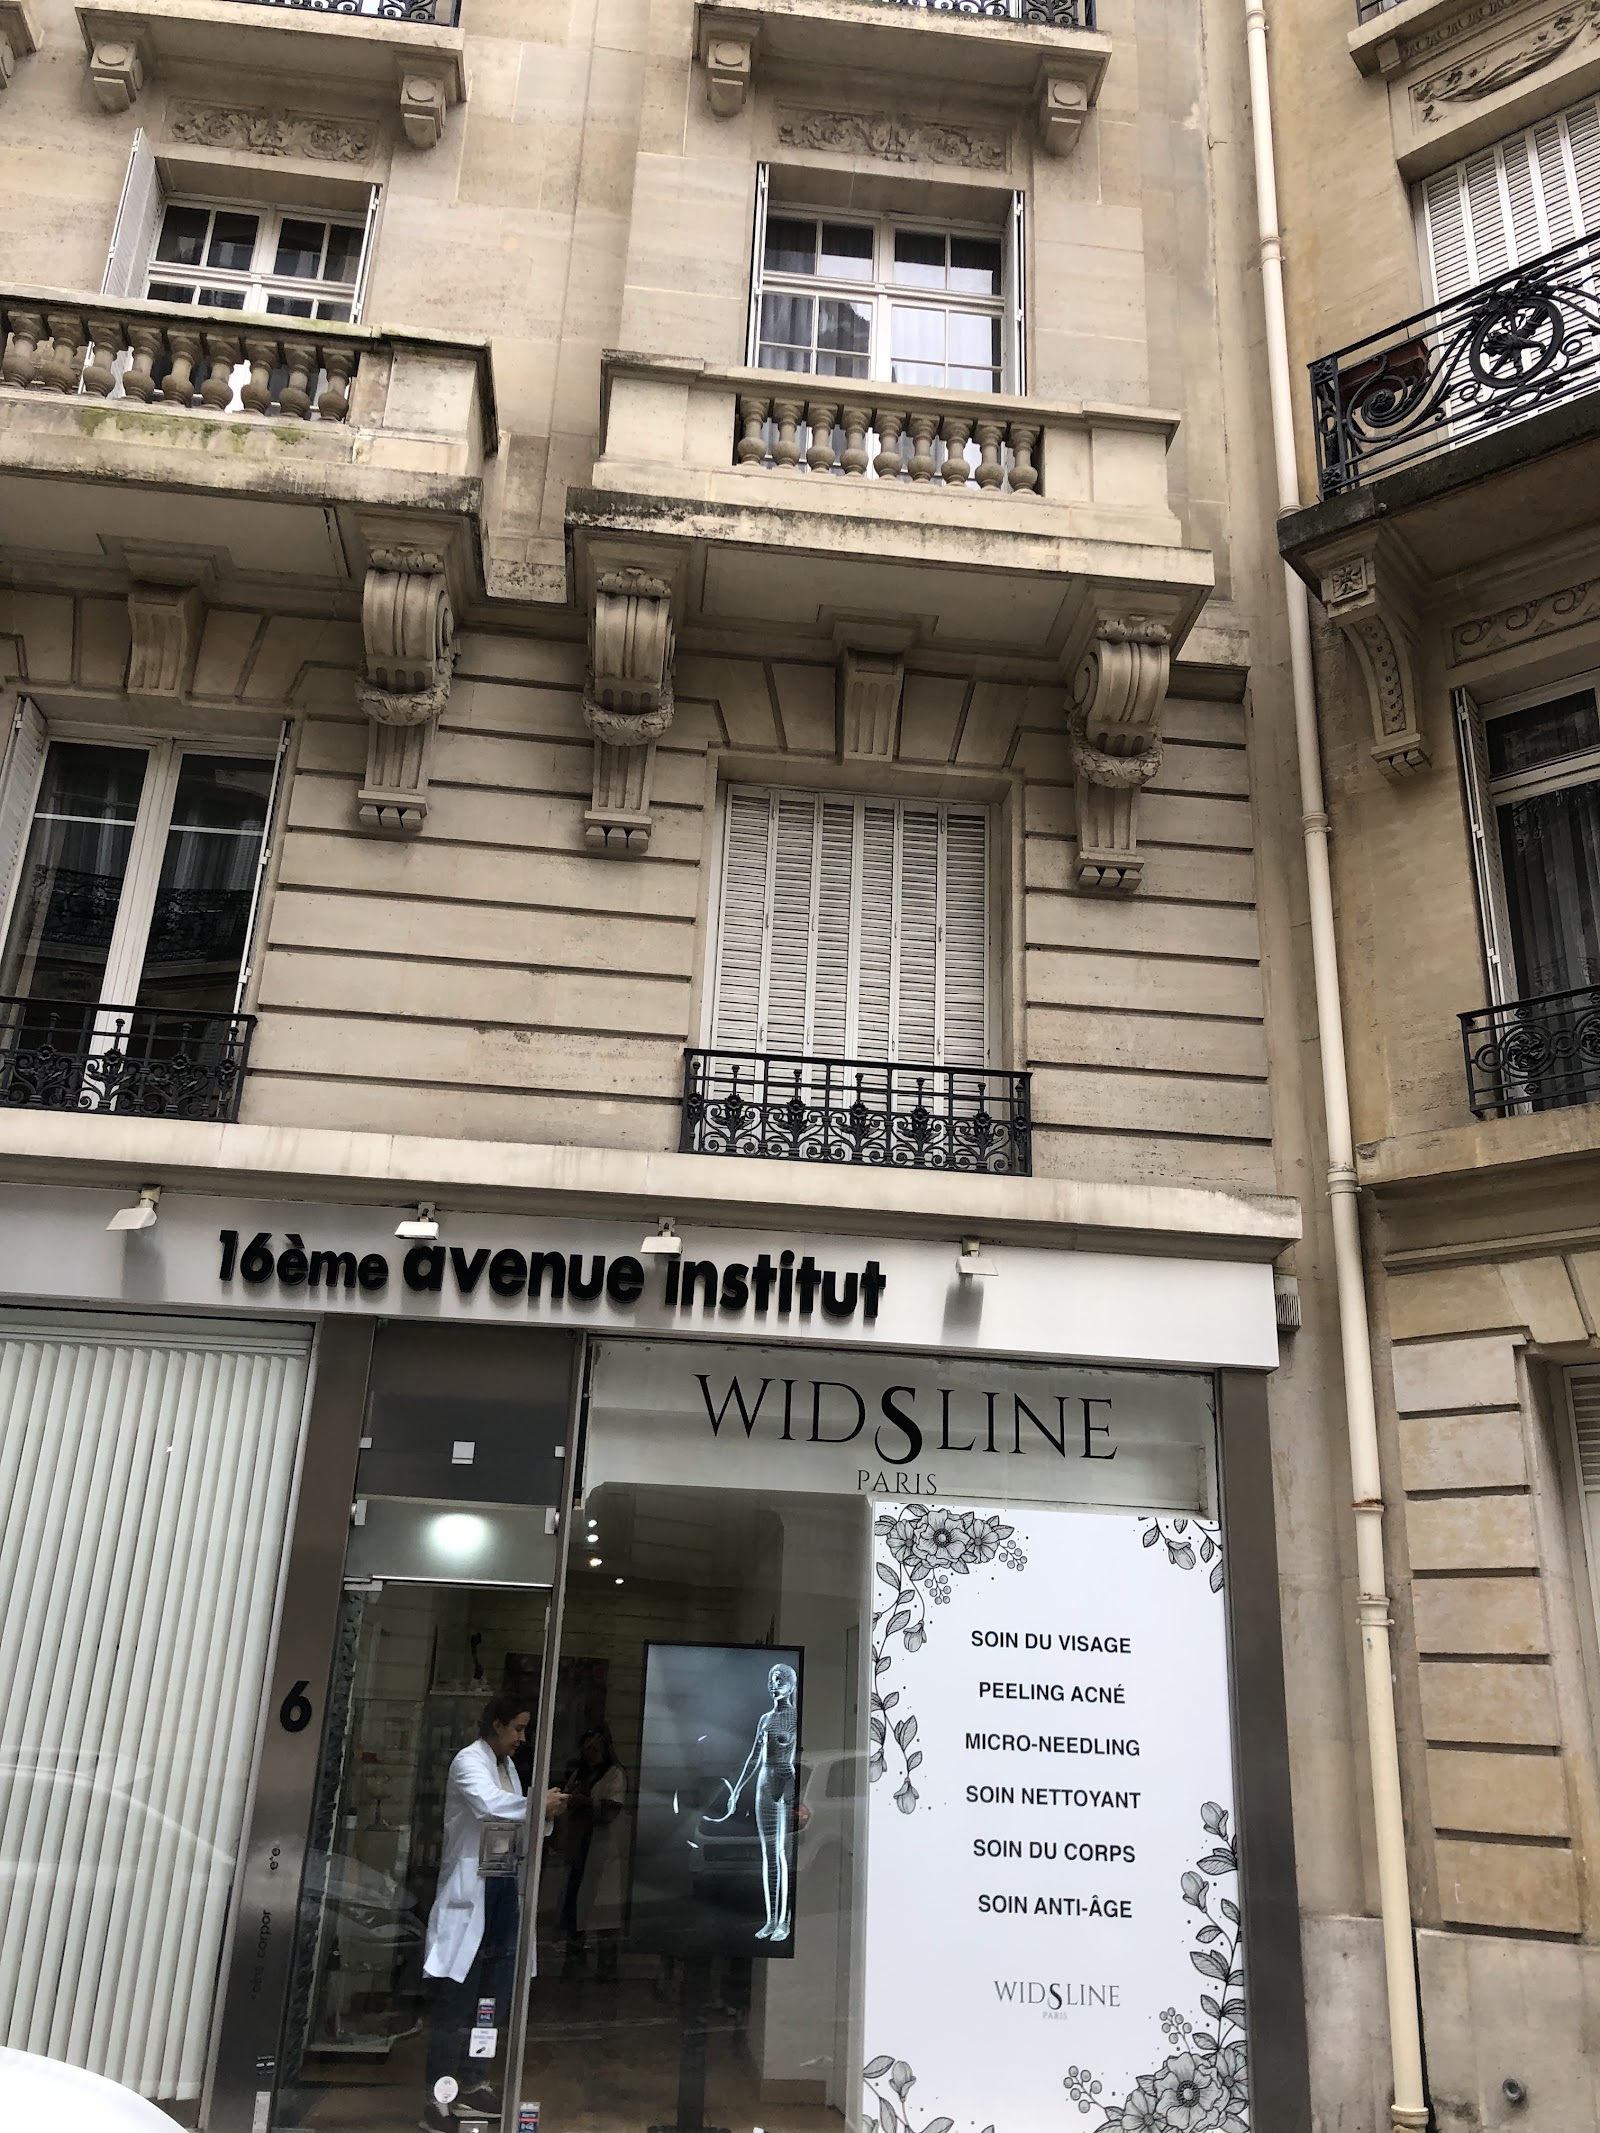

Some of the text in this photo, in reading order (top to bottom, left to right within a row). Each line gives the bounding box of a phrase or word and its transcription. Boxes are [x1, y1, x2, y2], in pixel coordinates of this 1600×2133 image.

[219, 1229, 887, 1319] 16ème avenue institut
[693, 1373, 1118, 1465] WIDSLINE
[856, 1468, 938, 1496] PARIS
[971, 1630, 1132, 1654] SOIN DU VISAGE
[979, 1681, 1126, 1704] PEELING ACNÉ
[279, 1680, 313, 1733] 6
[965, 1732, 1140, 1757] MICRO-NEEDLING
[966, 1785, 1141, 1809] SOIN NETTOYANT
[973, 1838, 1136, 1863] SOIN DU CORPS
[978, 1894, 1133, 1919] SOIN ANTI-ÂGE
[993, 1980, 1121, 2011] WIDSLINE
[1042, 2011, 1068, 2021] PARIS
